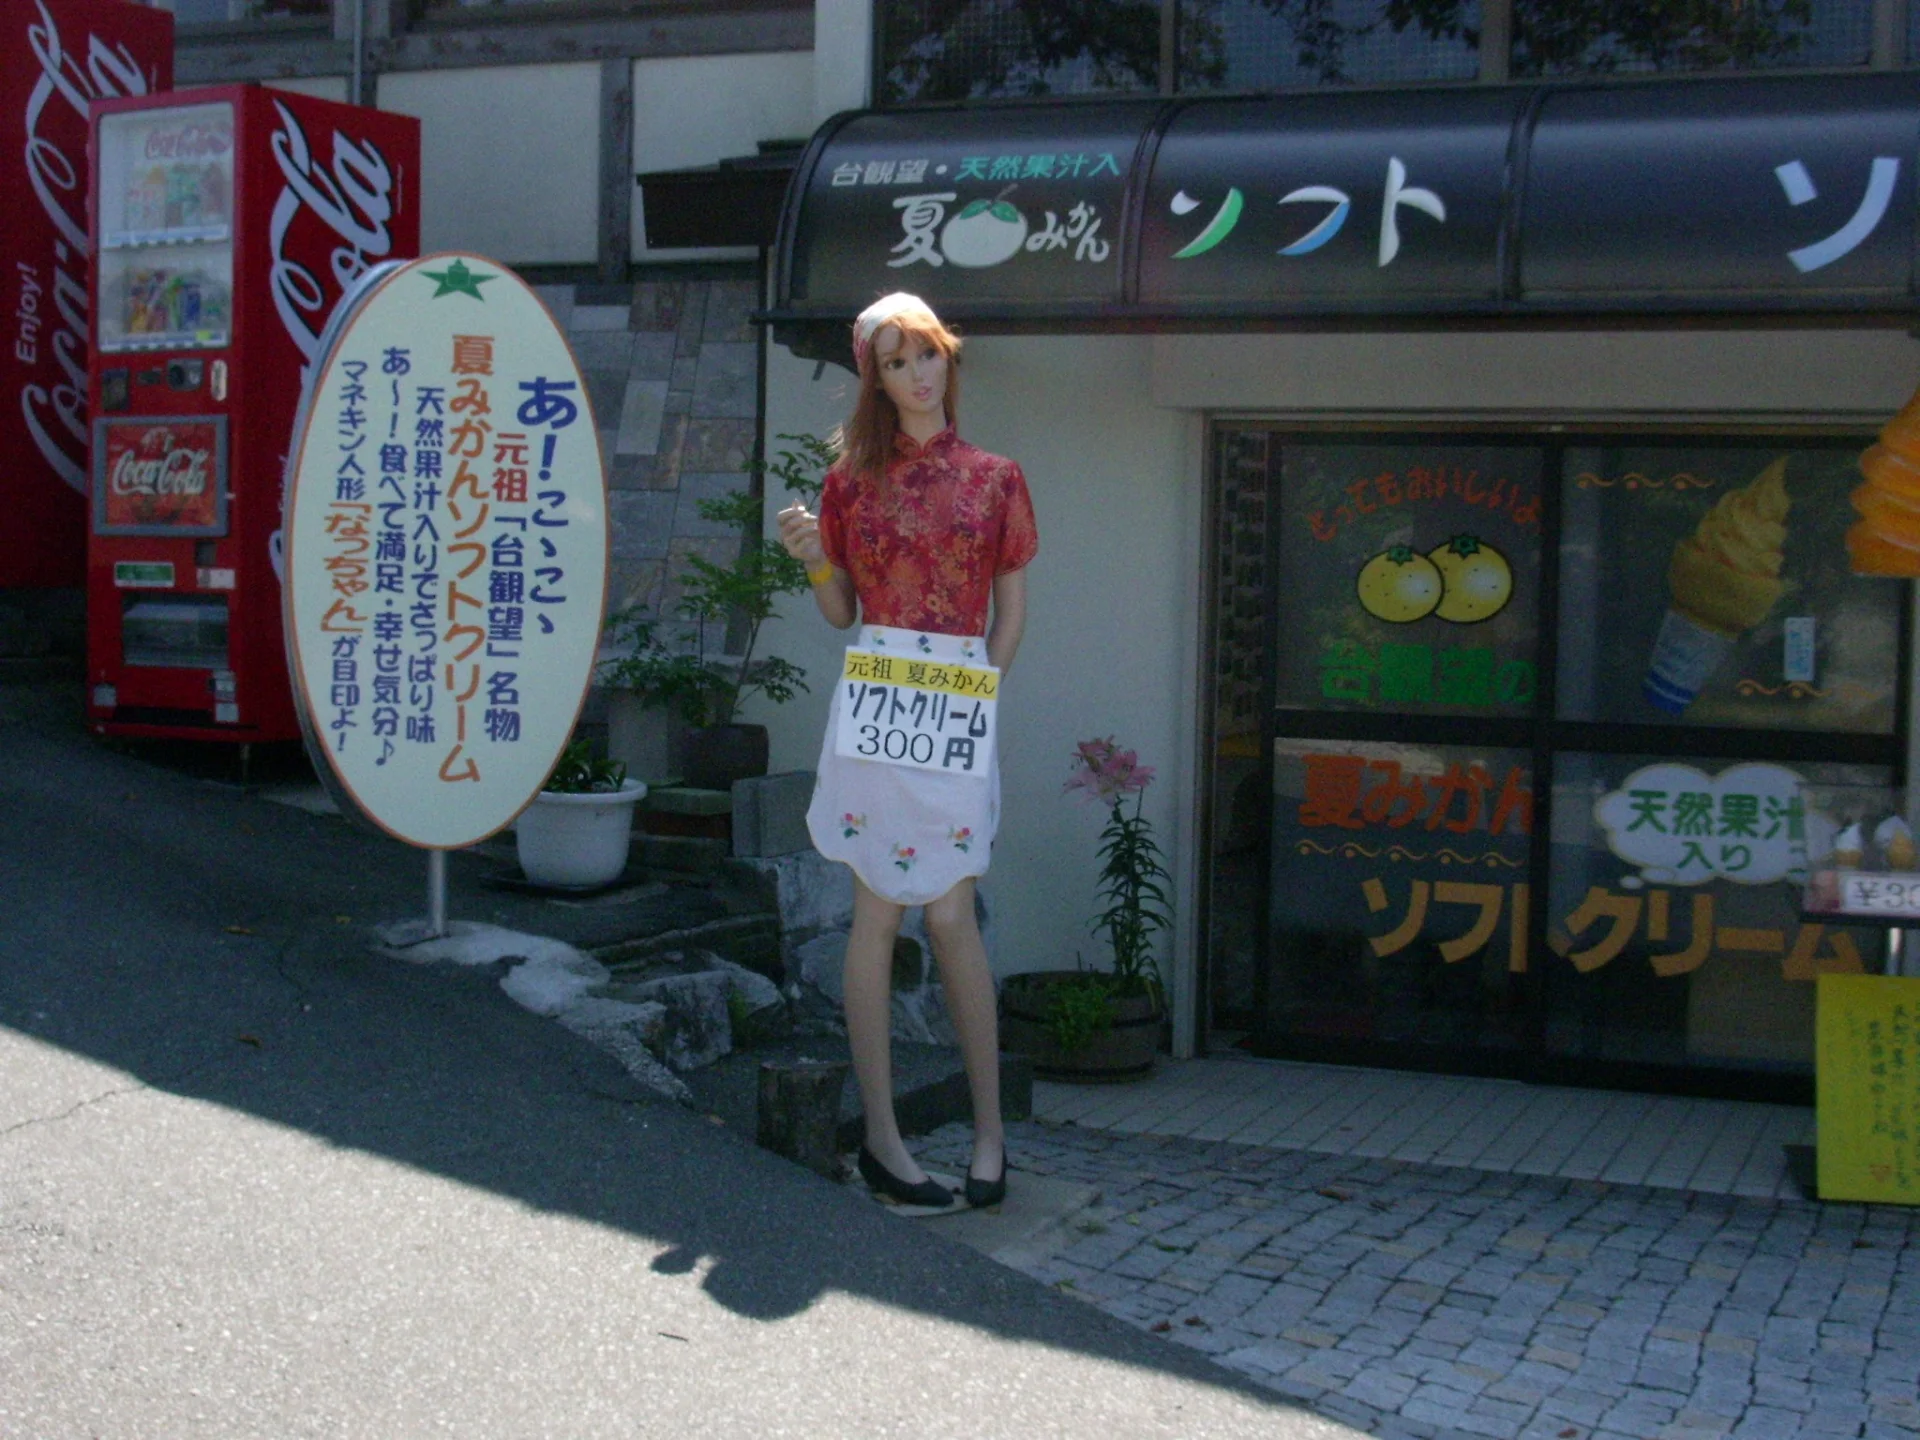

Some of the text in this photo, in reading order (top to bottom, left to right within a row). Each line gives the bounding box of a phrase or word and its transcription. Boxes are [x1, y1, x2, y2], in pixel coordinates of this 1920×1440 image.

[1169, 156, 1447, 268] ソフト
[1775, 157, 1900, 273] ソ
[16, 261, 42, 364] Enjoy!
[405, 386, 445, 743] 天然果汁入りでさっぱり味
[438, 334, 495, 782] 夏みかんソフトクリーム
[847, 655, 996, 696] 元祖 夏みかん
[848, 682, 988, 738] ソフトクリーム
[1298, 754, 1536, 836] 夏みかん
[1626, 789, 1805, 842] 天然果汁
[1678, 840, 1753, 872] 入り
